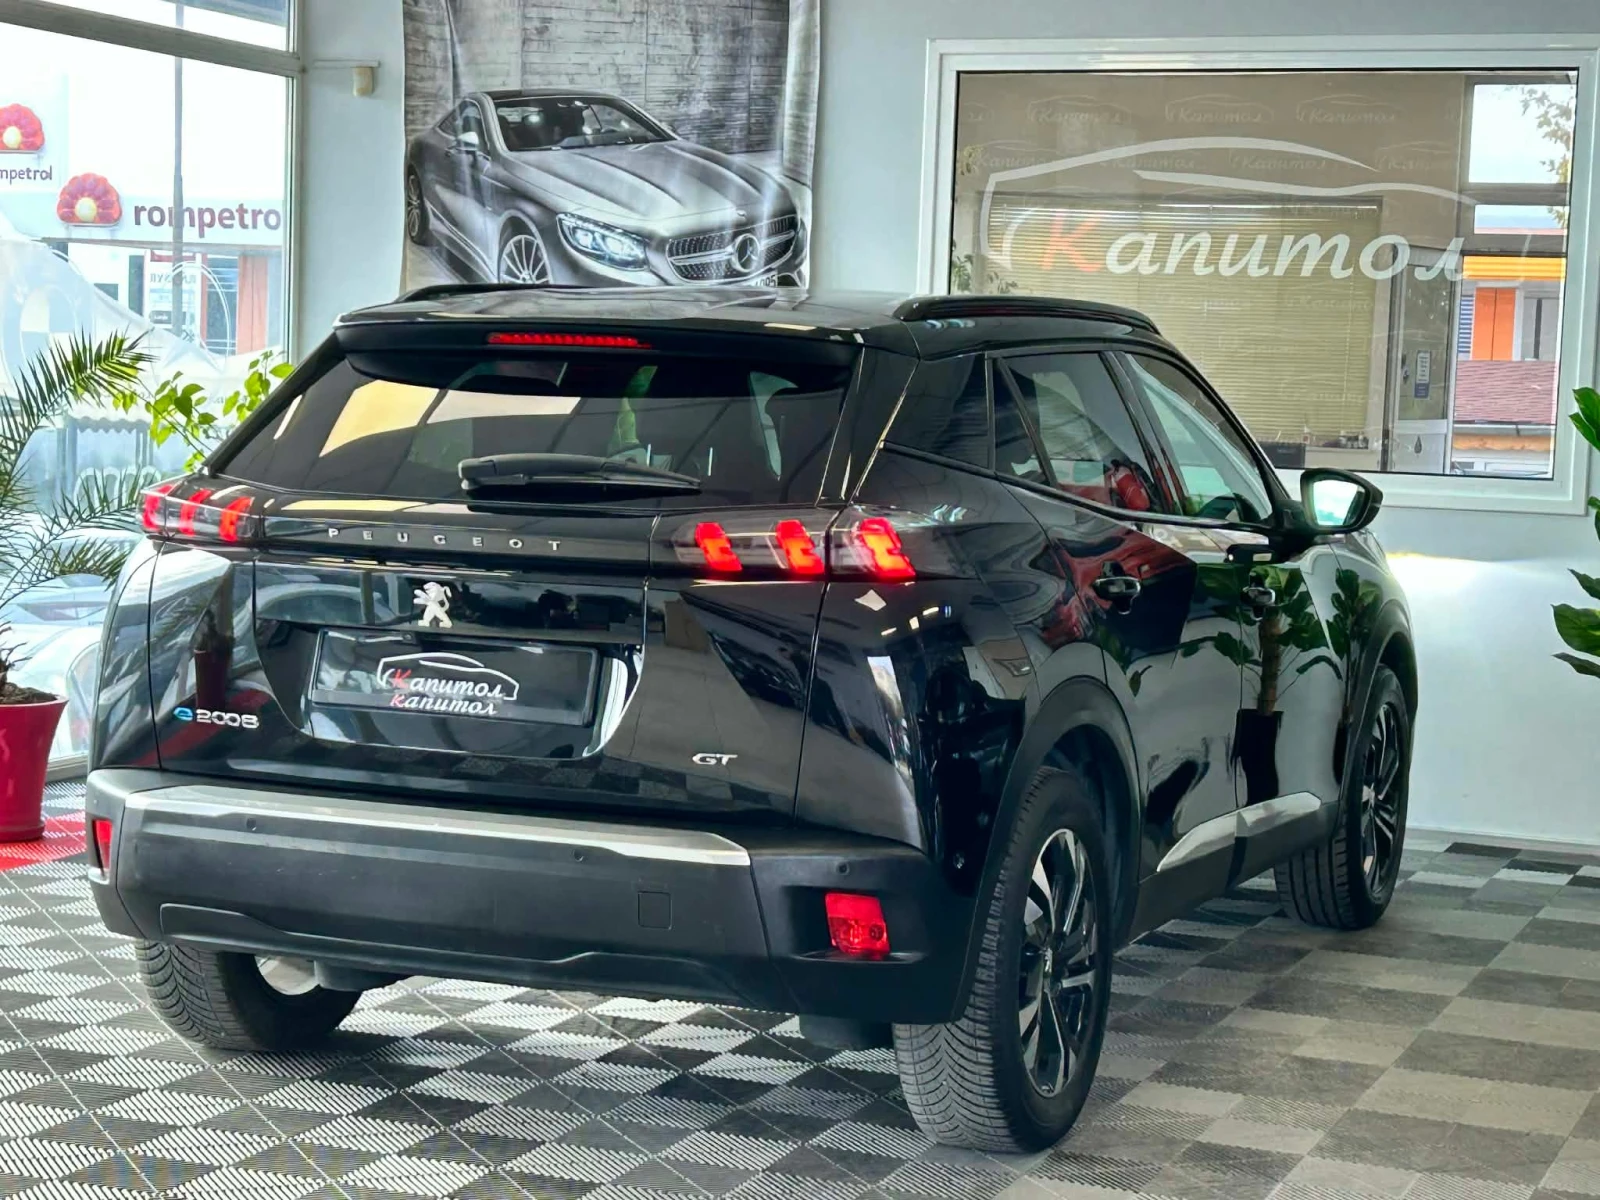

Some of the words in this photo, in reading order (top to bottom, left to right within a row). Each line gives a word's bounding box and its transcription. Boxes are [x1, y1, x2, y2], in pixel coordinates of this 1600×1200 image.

[1040, 208, 1466, 281] Капитол
[328, 528, 561, 551] PEUGEOT
[392, 668, 505, 698] Капитол
[692, 753, 738, 766] GT
